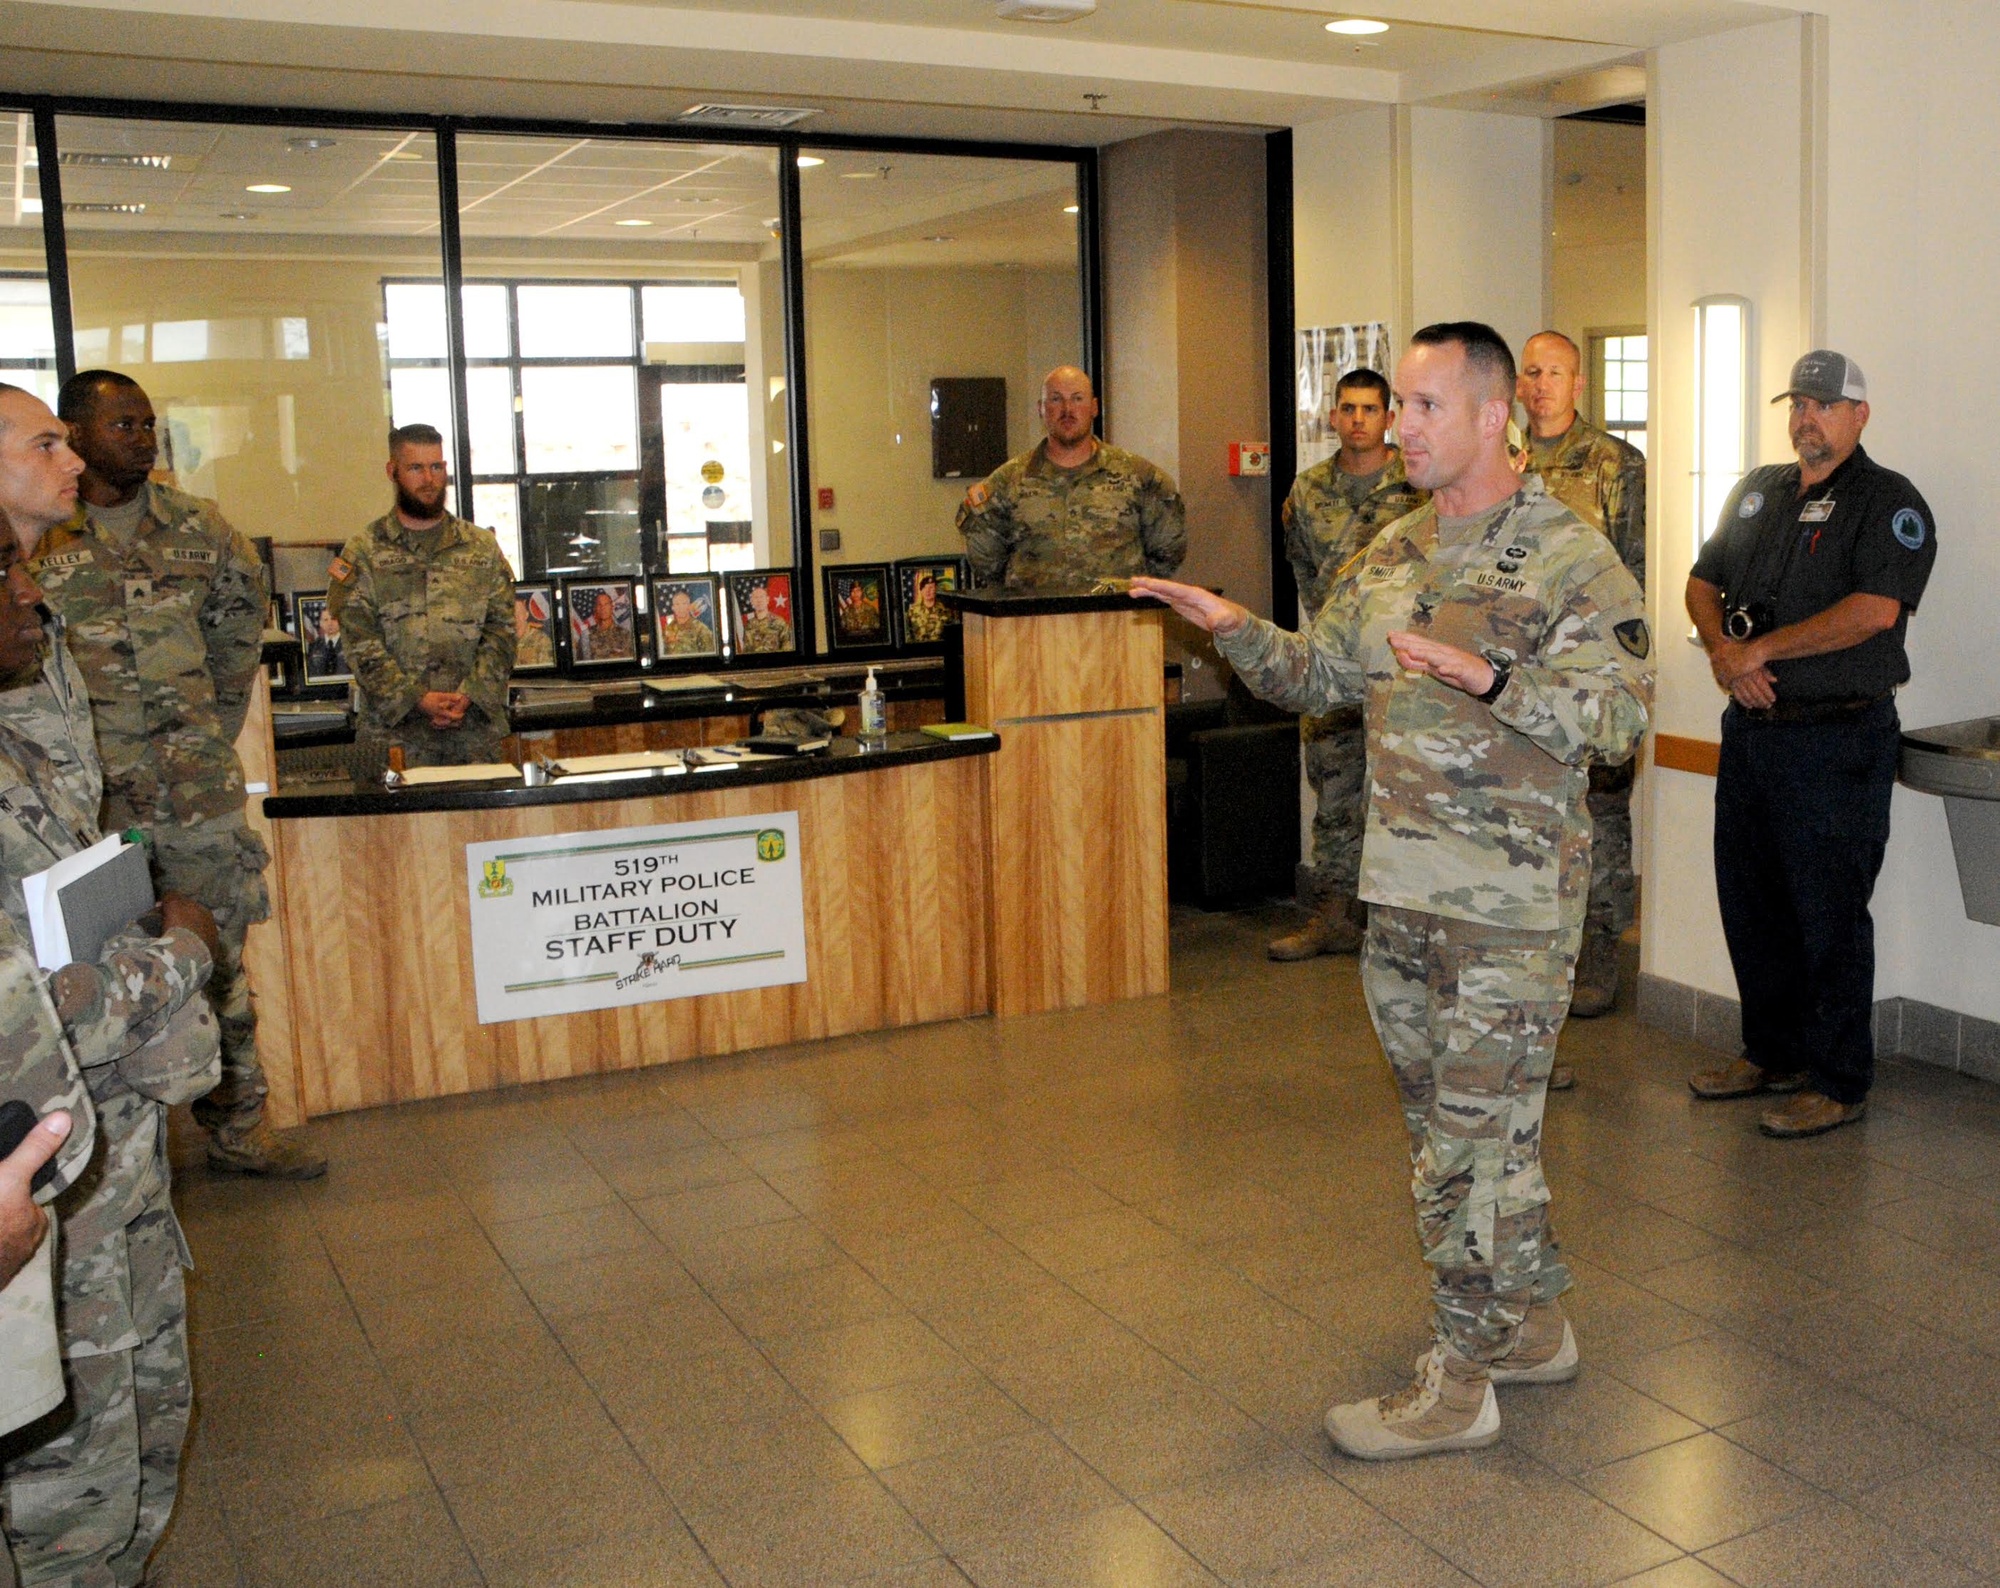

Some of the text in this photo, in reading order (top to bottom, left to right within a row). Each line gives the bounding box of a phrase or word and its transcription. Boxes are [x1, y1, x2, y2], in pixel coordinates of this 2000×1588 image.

[39, 553, 81, 568] KELLEY
[189, 551, 211, 561] ARMY
[1369, 566, 1397, 578] SMITH
[1494, 577, 1526, 593] ARMY
[614, 854, 679, 876] 519TH
[532, 867, 755, 908] MILITARY POLICE
[574, 899, 719, 931] BATTALION
[546, 919, 738, 960] STAFF DUTY
[615, 953, 681, 990] STRIKE HARD
